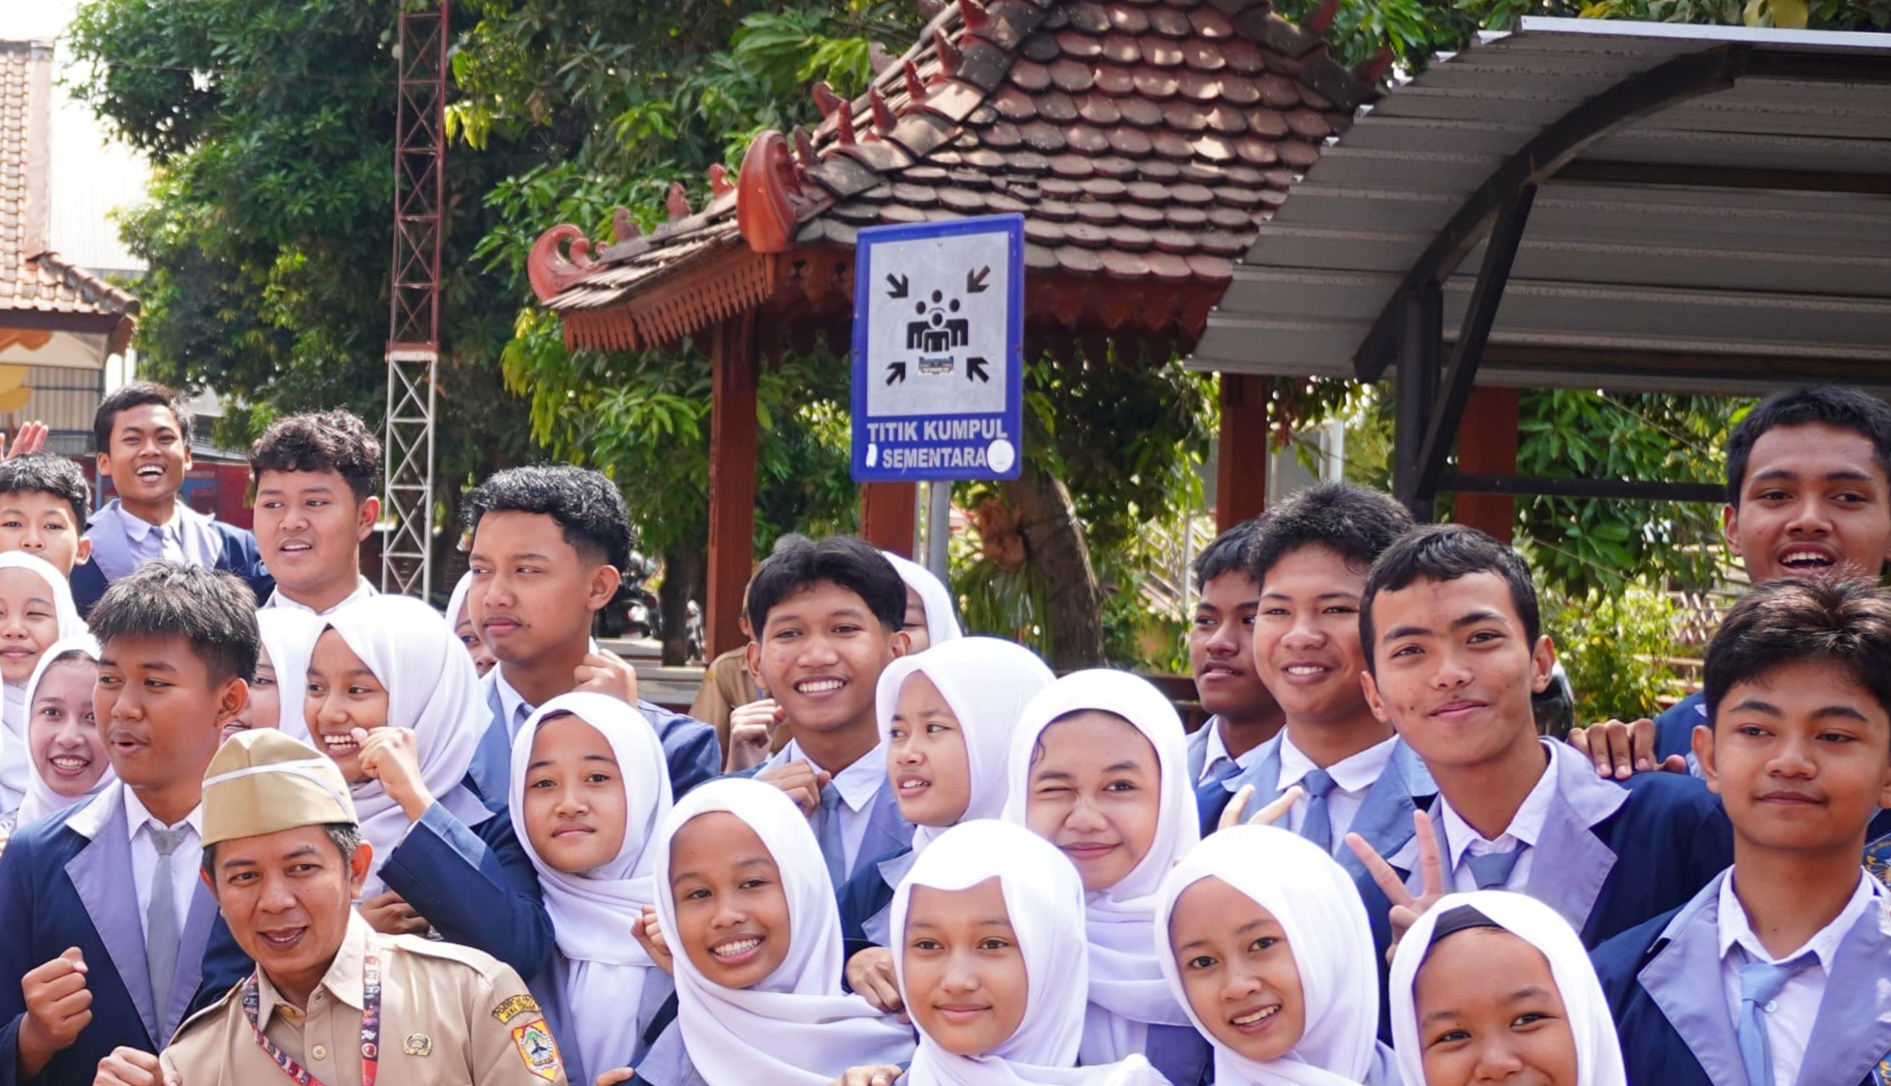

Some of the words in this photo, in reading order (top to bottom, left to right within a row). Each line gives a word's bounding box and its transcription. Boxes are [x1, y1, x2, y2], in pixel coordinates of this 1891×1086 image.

[867, 421, 918, 442] TITIK
[923, 418, 1008, 441] KUMPUL
[882, 447, 988, 468] SEMENTARA
